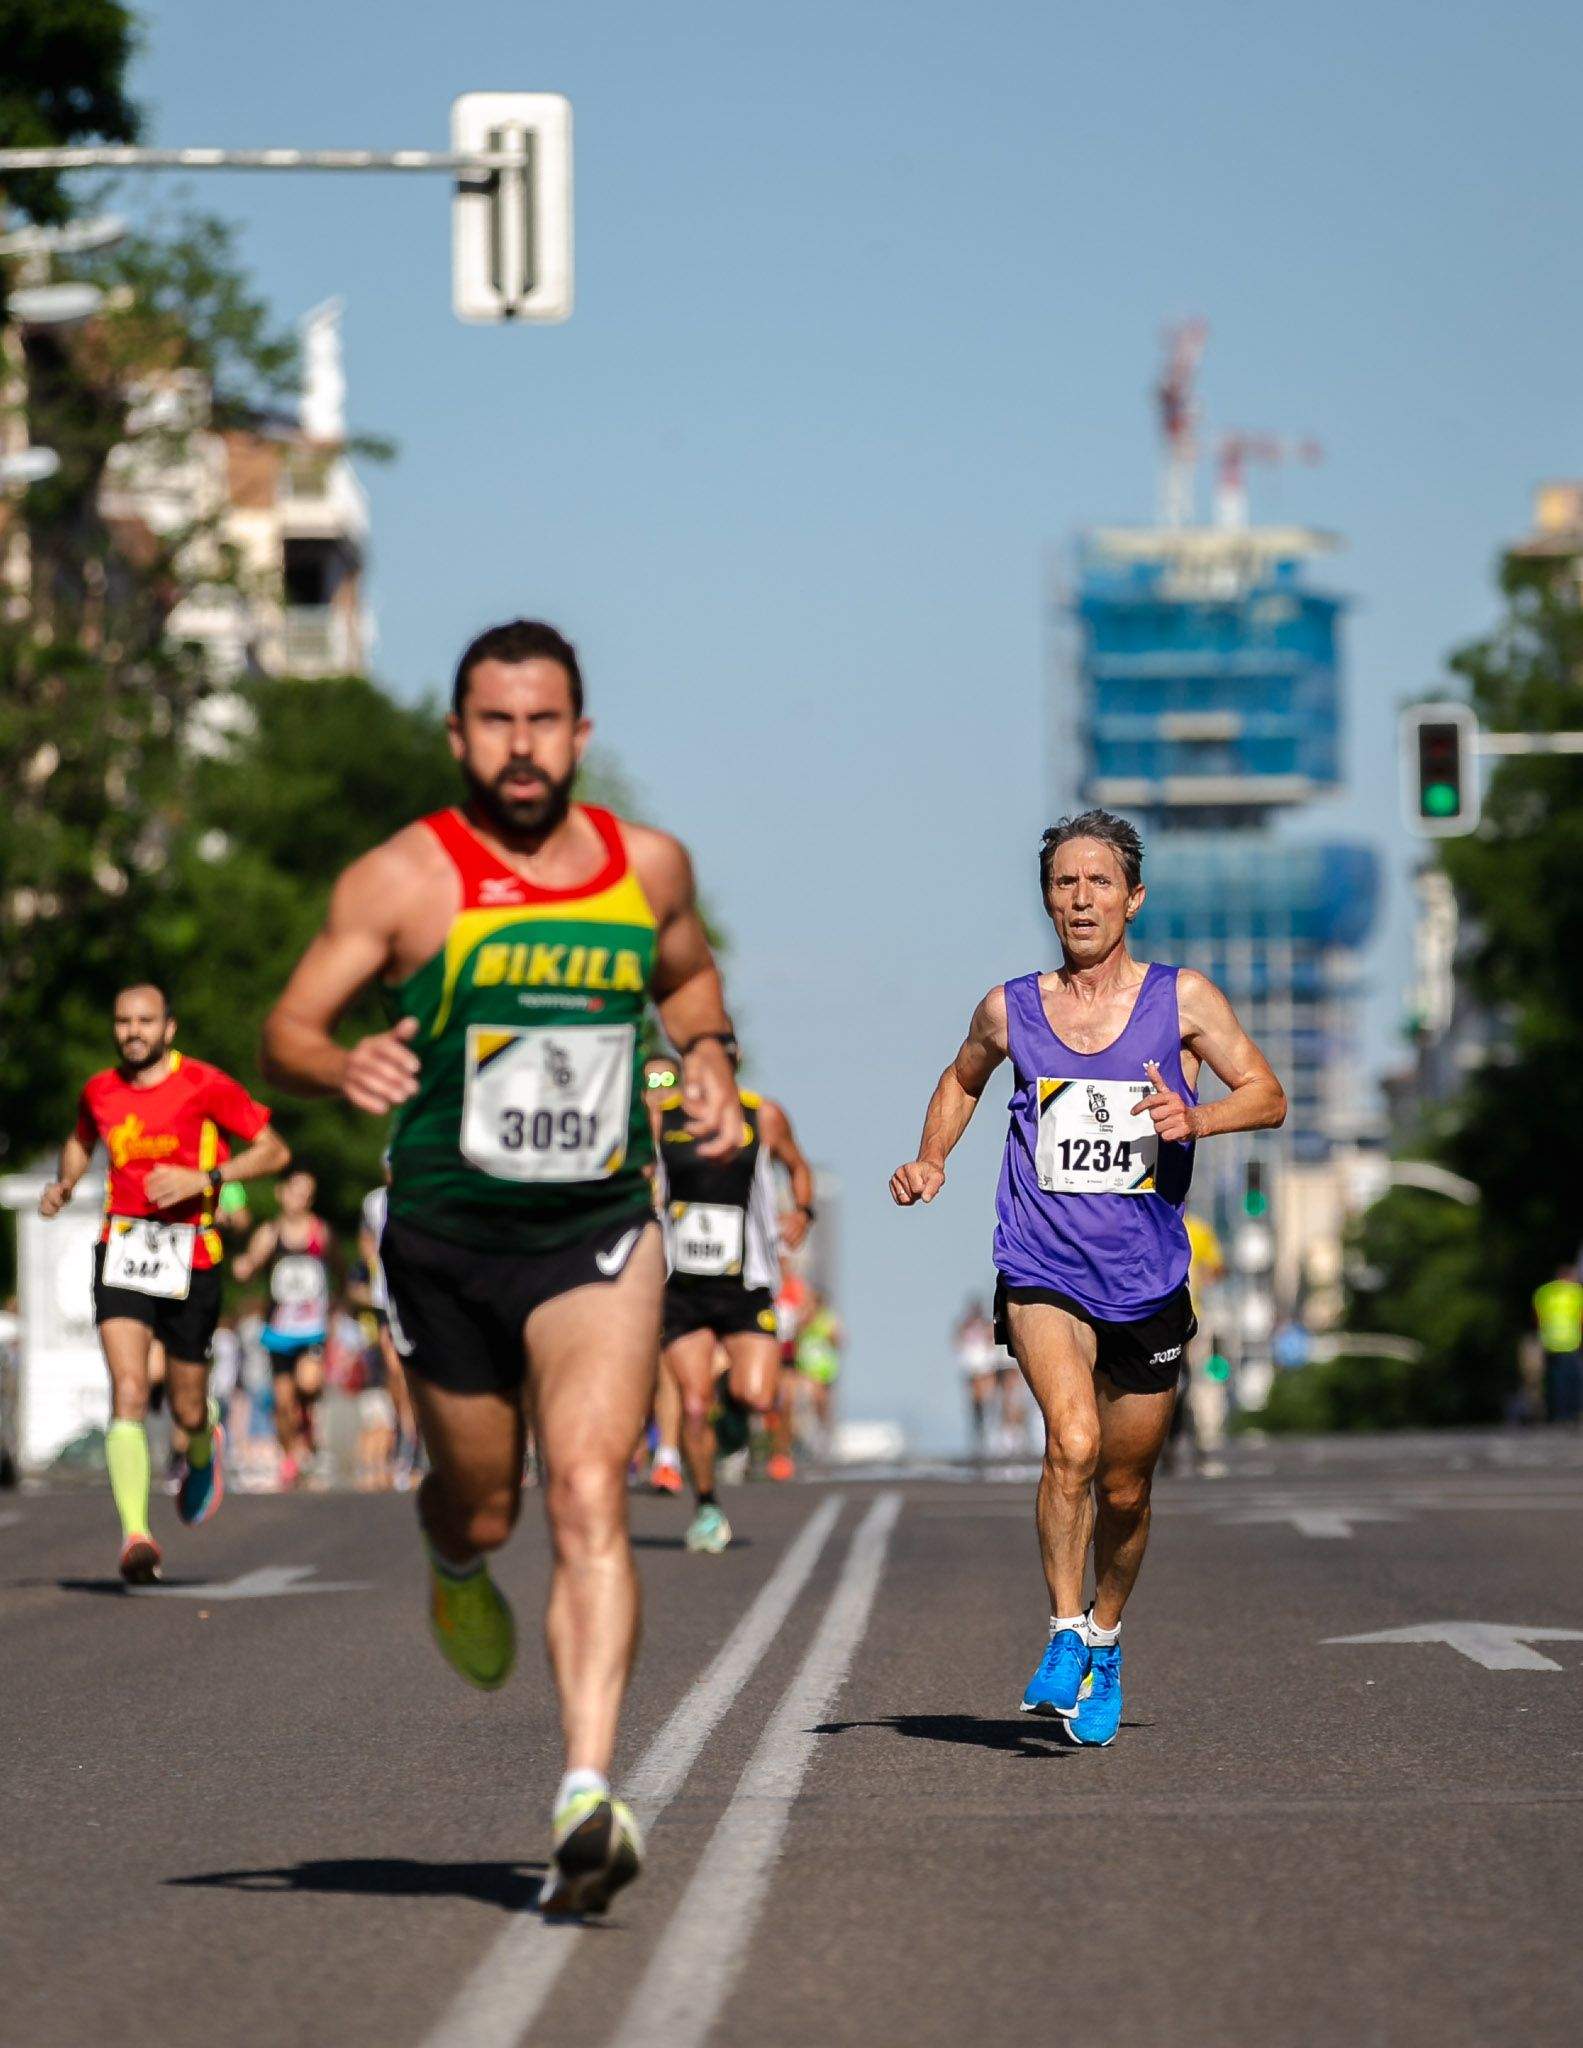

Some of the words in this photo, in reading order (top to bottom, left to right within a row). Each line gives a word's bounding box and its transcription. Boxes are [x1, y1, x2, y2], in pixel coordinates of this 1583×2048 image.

[472, 943, 643, 991] BIKILA
[502, 1110, 597, 1149] 3091
[1057, 1138, 1132, 1172] 1234
